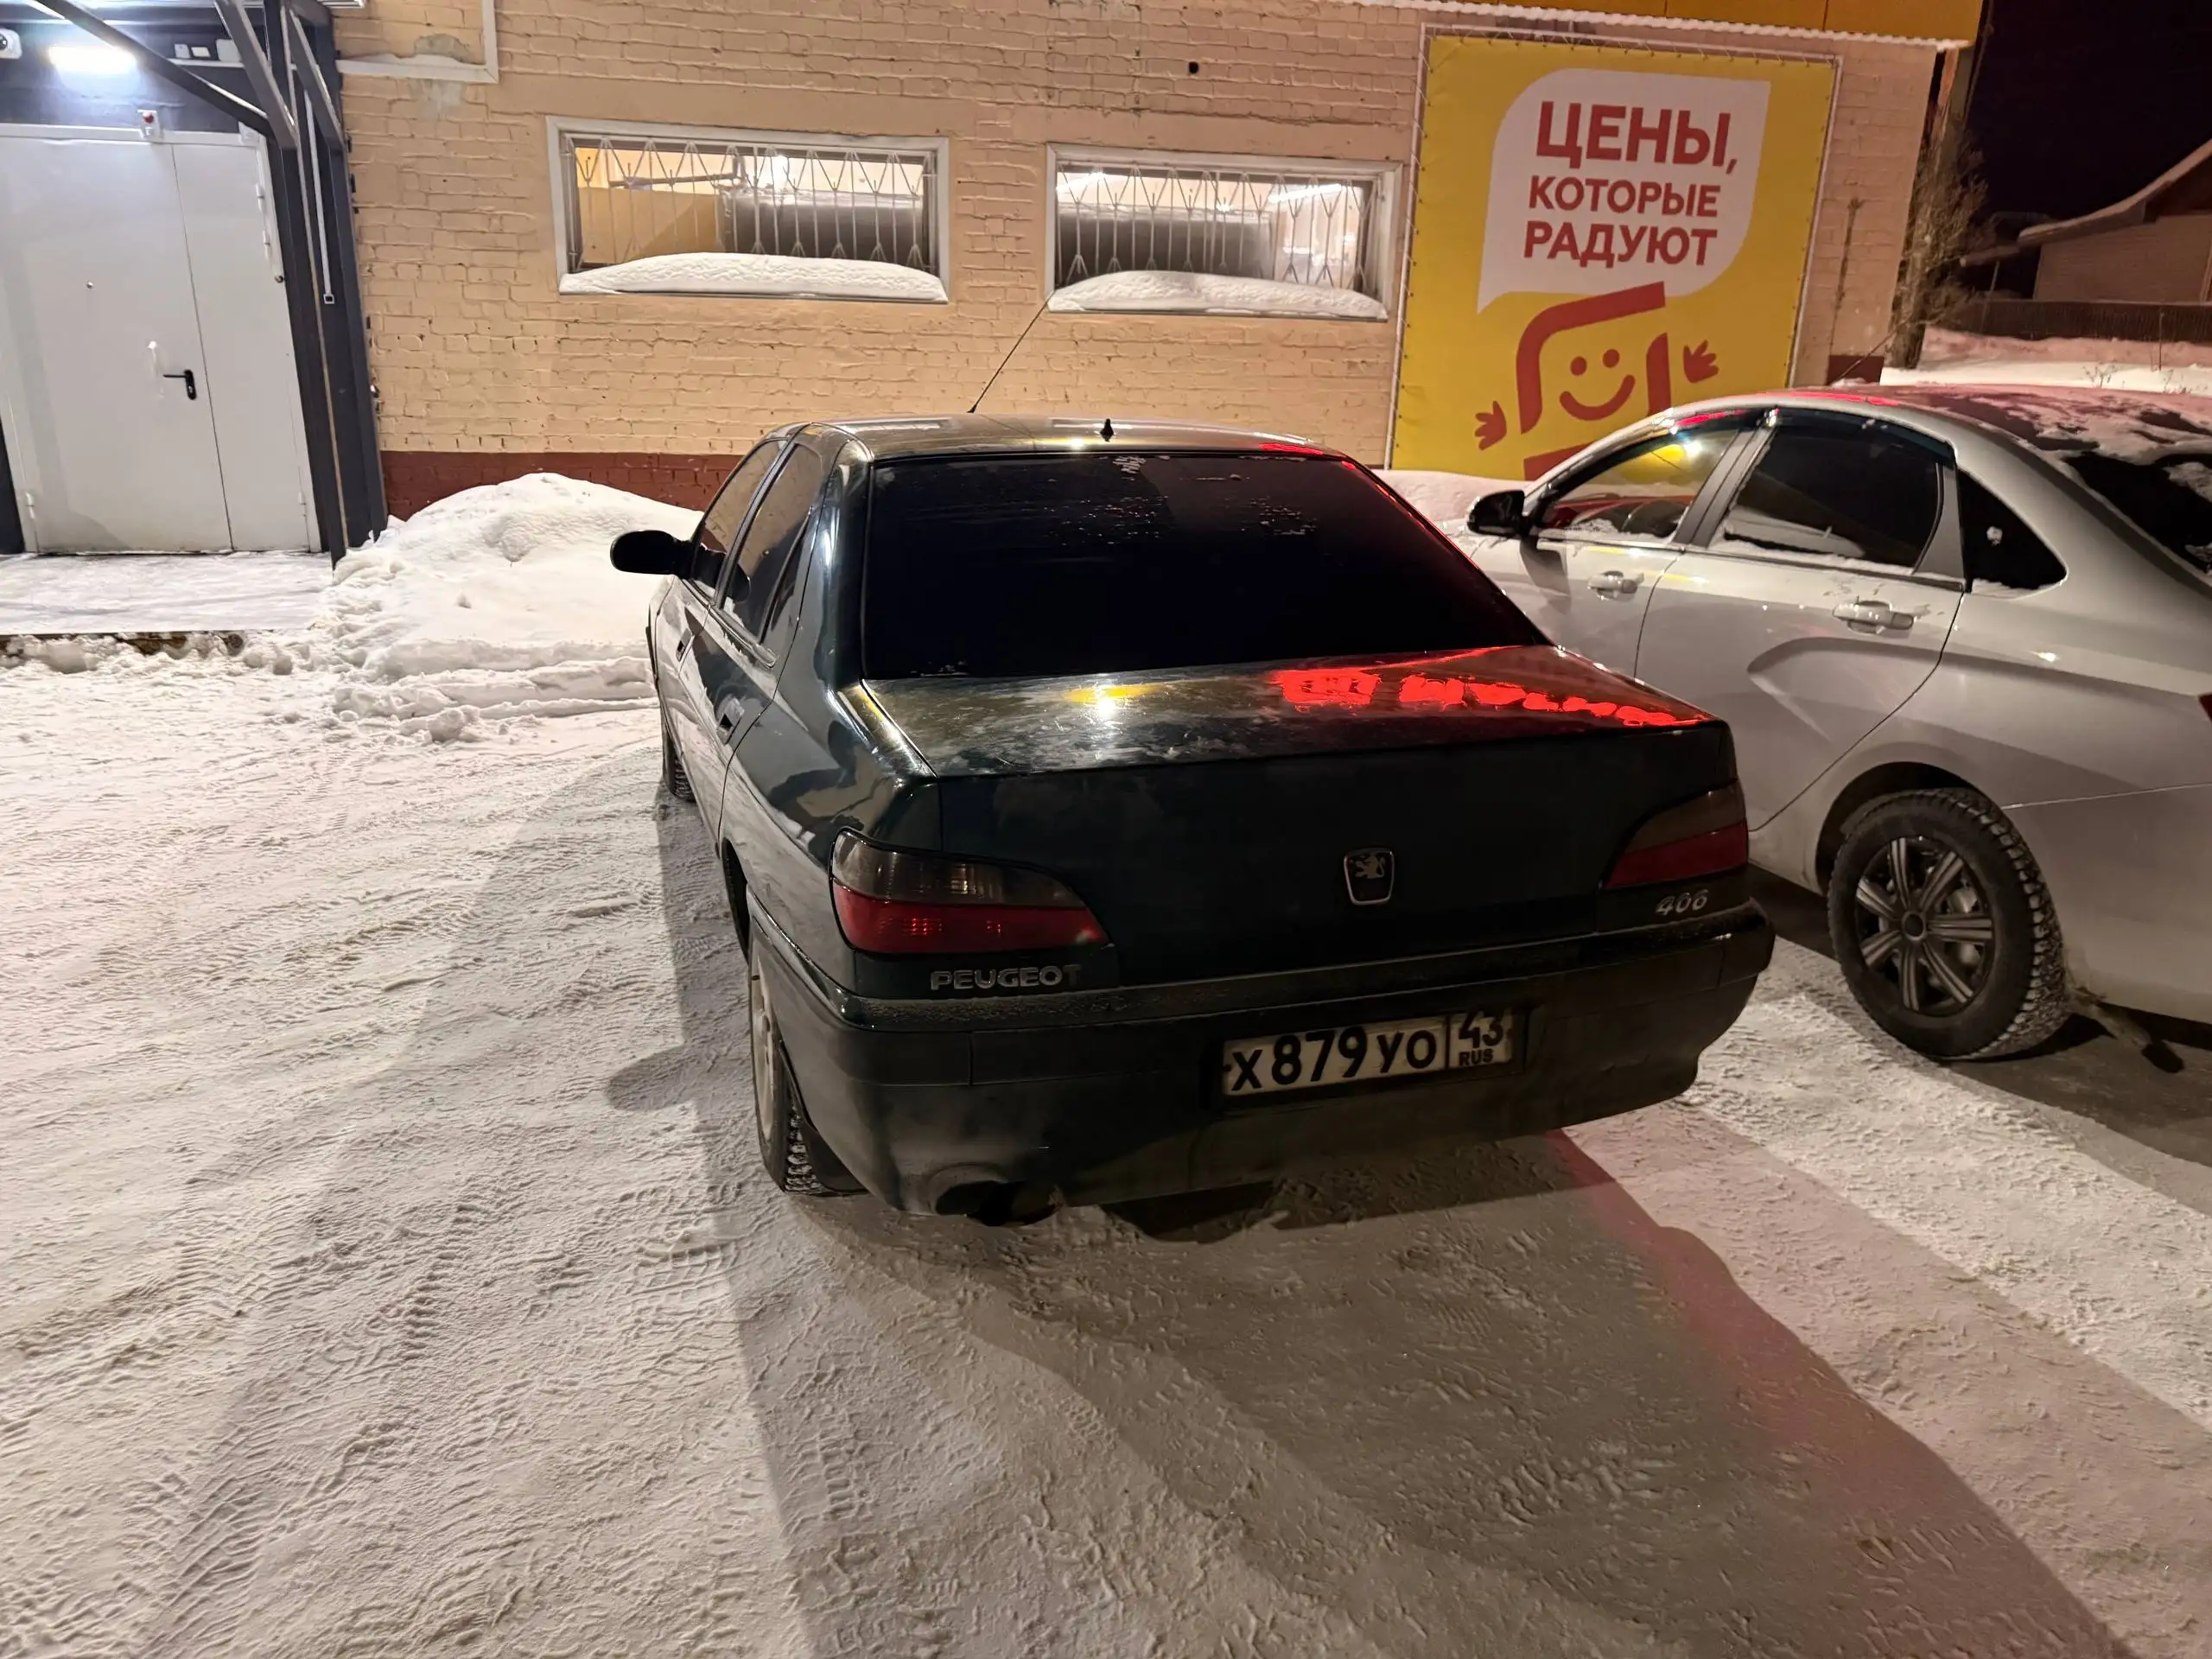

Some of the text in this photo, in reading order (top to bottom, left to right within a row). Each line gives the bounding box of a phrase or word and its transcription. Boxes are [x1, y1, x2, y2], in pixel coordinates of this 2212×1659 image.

[1536, 101, 1737, 175] ЦЕНЫ,
[1529, 175, 1721, 218] КОТОРЫЕ
[1524, 221, 1718, 268] РАДУЮТ
[1656, 889, 1709, 916] 406
[930, 963, 1082, 991] PEUGEOT
[1459, 1009, 1504, 1050] 43
[1459, 1048, 1494, 1067] RUS
